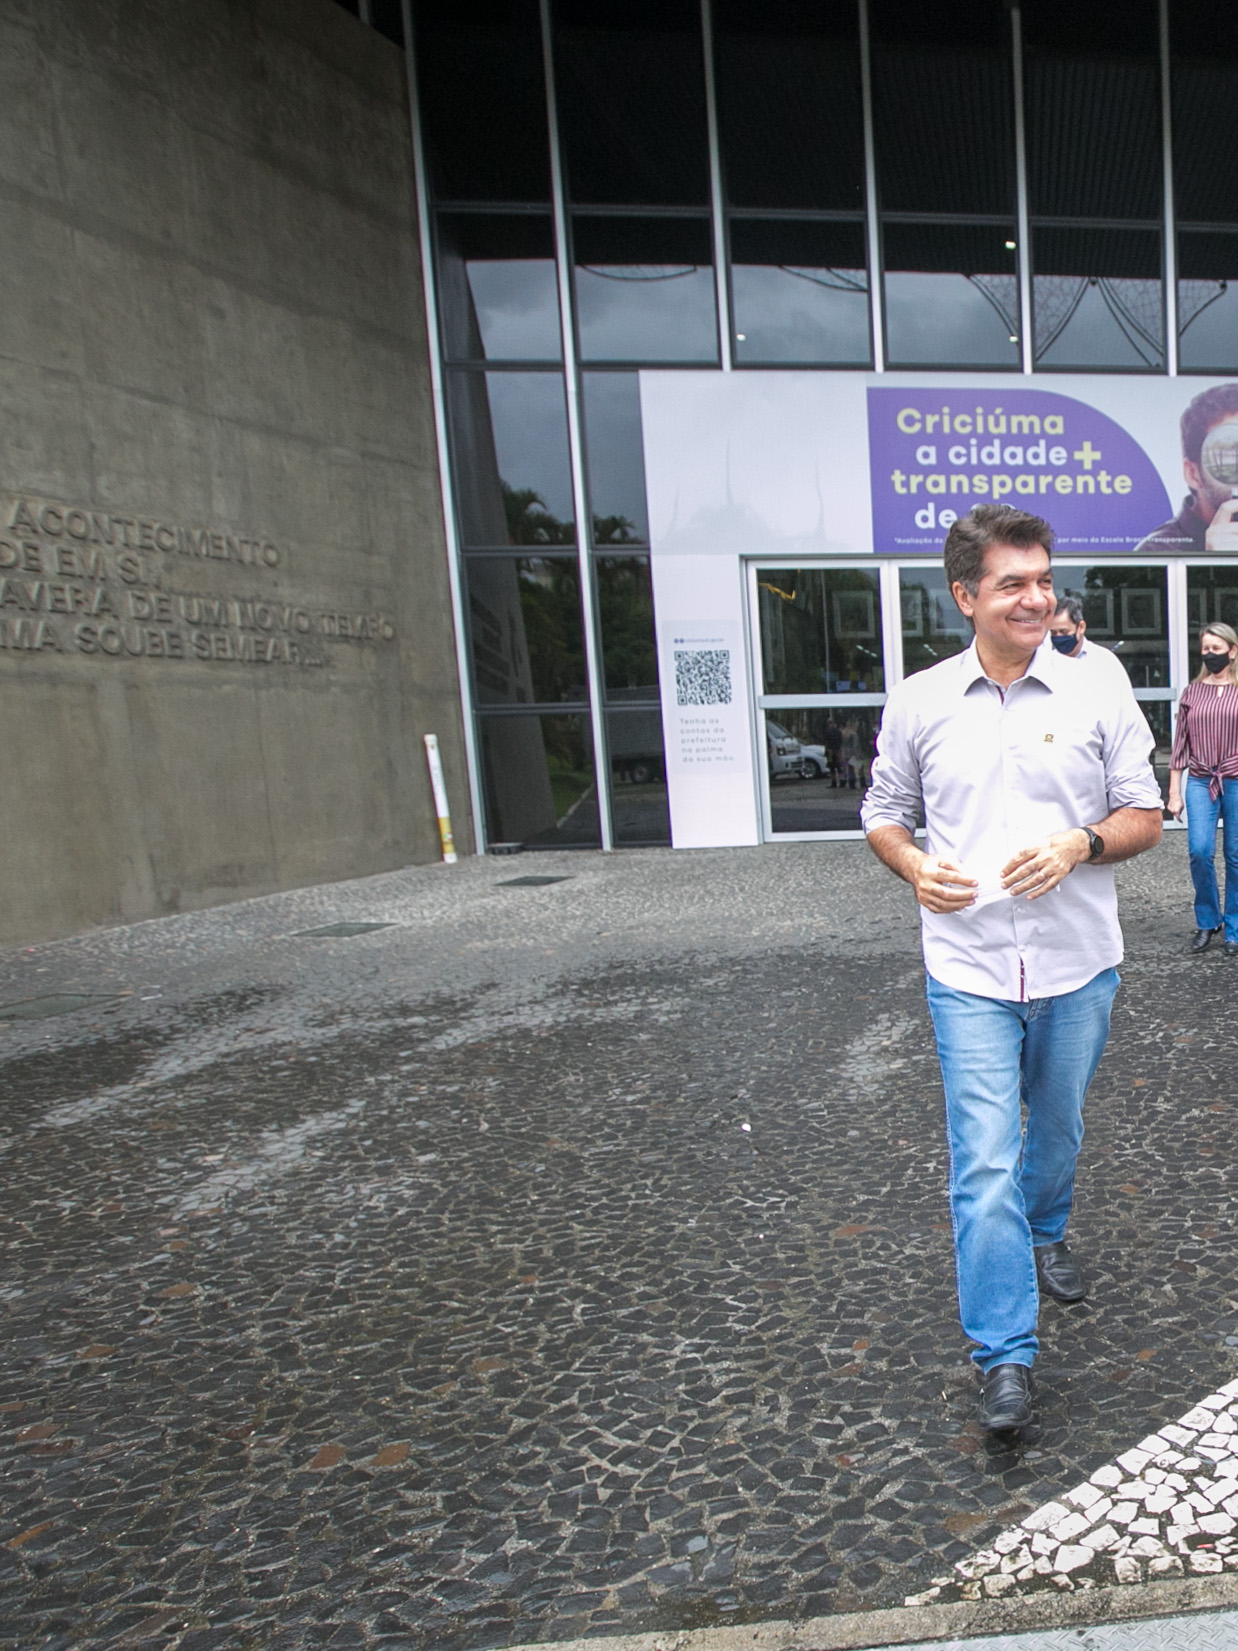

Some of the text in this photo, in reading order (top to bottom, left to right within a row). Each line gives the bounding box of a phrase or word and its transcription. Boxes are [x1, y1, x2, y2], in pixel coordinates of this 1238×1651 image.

[897, 407, 1064, 434] Criciúma
[916, 444, 937, 466] a
[948, 439, 1067, 466] cidade
[891, 470, 1132, 499] transparente
[914, 502, 957, 529] de
[8, 501, 281, 567] ACONTECIMENTO
[56, 547, 107, 582] EM
[128, 590, 173, 623] DE
[179, 597, 228, 628] UM
[234, 601, 313, 634] NOVO
[319, 611, 397, 641] TEMPO
[75, 623, 184, 658] SOUBE
